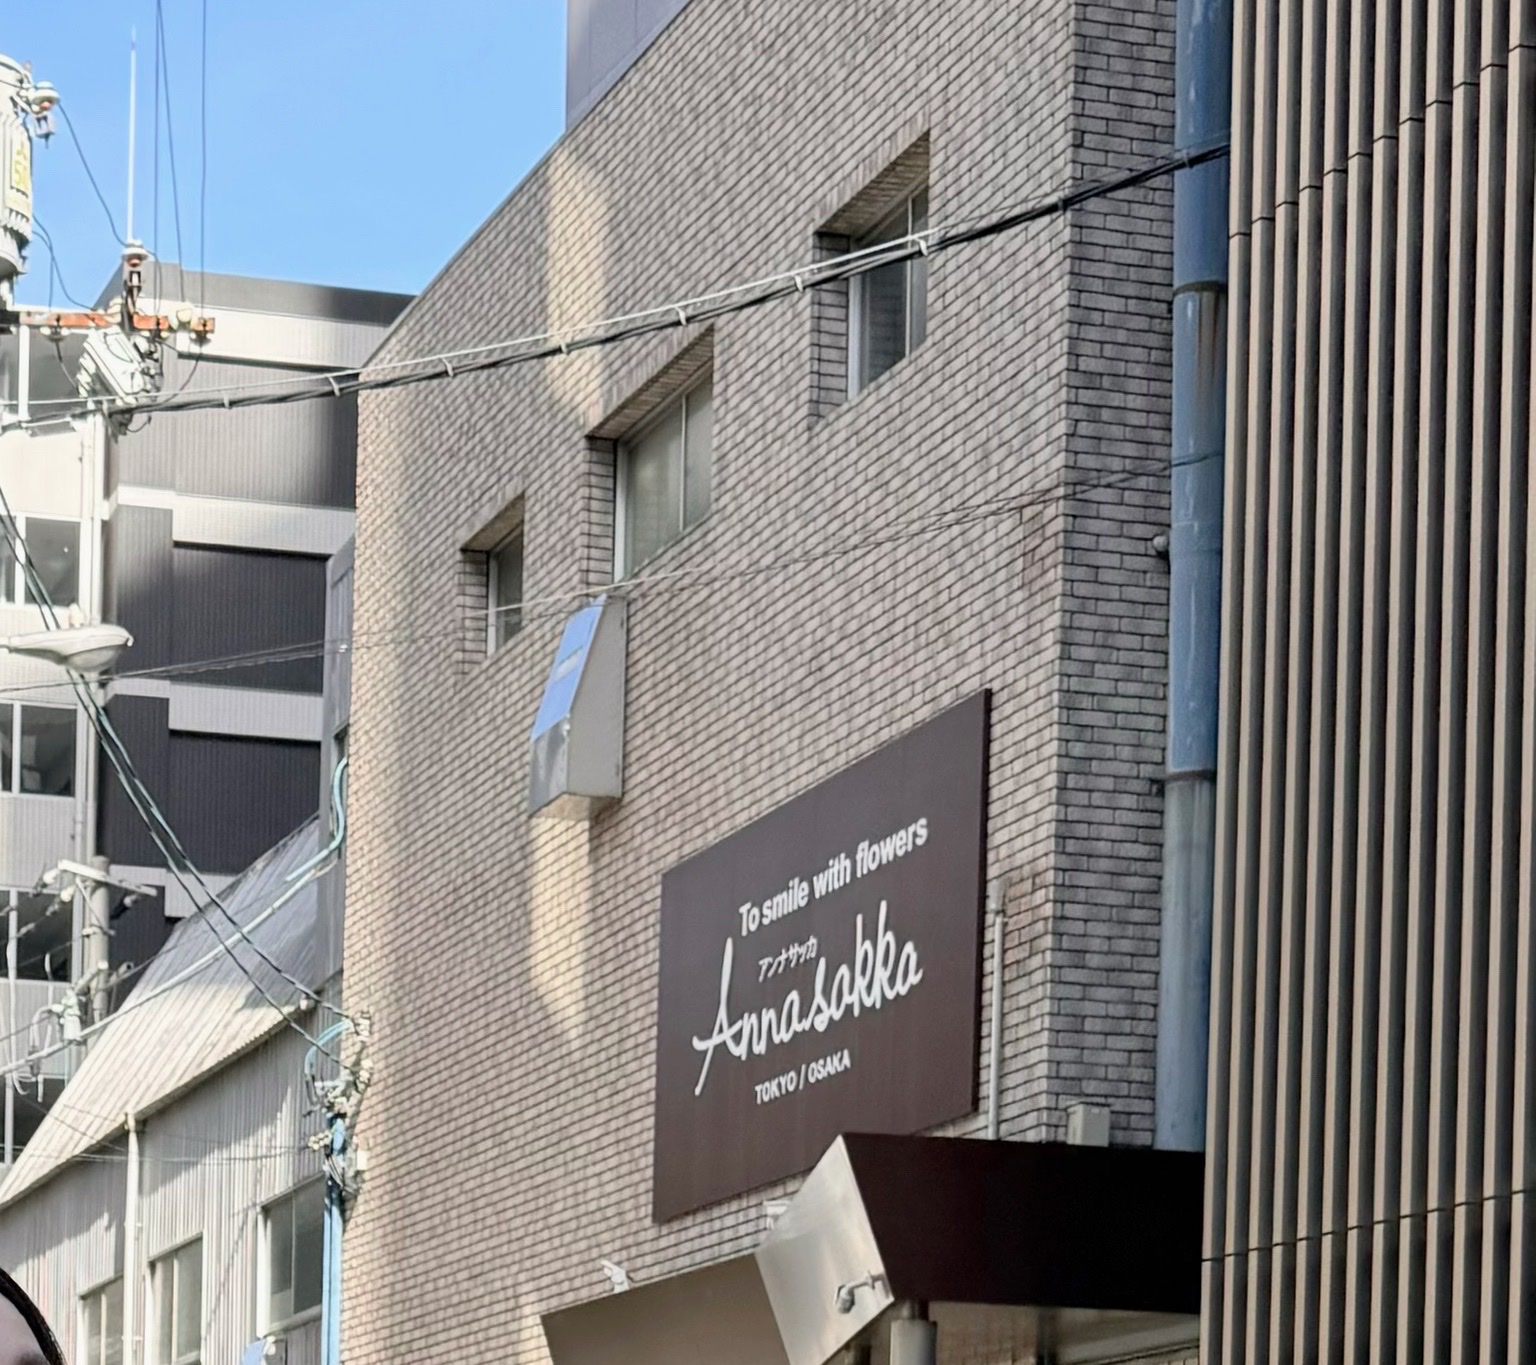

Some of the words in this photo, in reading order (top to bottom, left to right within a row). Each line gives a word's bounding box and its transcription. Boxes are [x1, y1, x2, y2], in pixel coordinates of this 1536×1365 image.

[738, 901, 760, 937] To
[761, 877, 809, 926] smile
[813, 852, 852, 899] with
[855, 817, 928, 878] flowers
[757, 934, 818, 983] アンナサッカ
[754, 1070, 797, 1105] TOKYO
[807, 1048, 851, 1083] OSAKA
